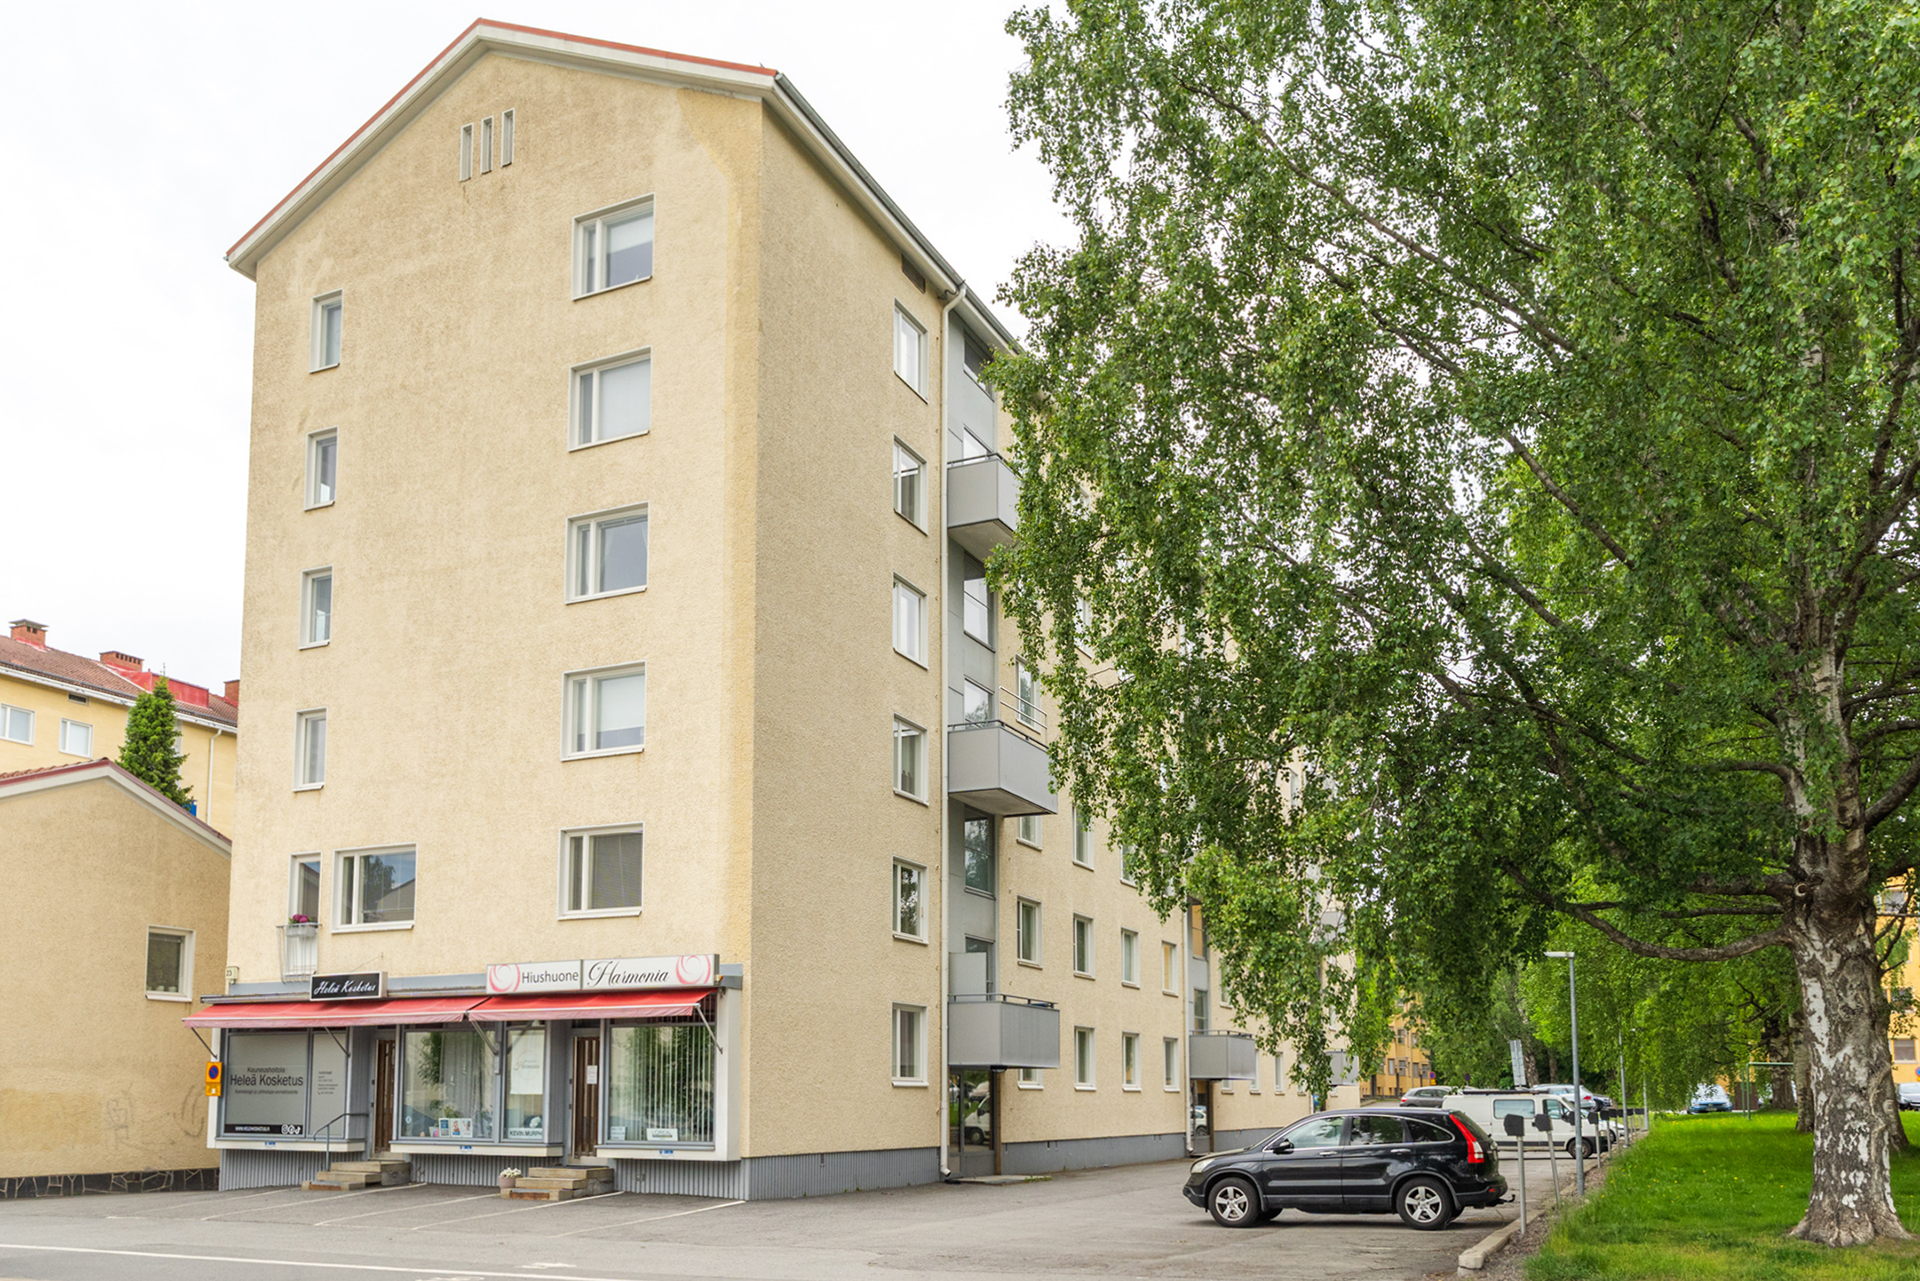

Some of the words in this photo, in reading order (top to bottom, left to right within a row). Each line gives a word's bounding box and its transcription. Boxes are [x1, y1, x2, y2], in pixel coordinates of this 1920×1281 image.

[522, 970, 580, 984] Hiushuone
[587, 960, 669, 987] Harmonia
[314, 980, 340, 995] Heleä
[341, 980, 377, 993] Kosketus
[230, 1074, 256, 1086] Heleä
[259, 1074, 304, 1086] Kosketus
